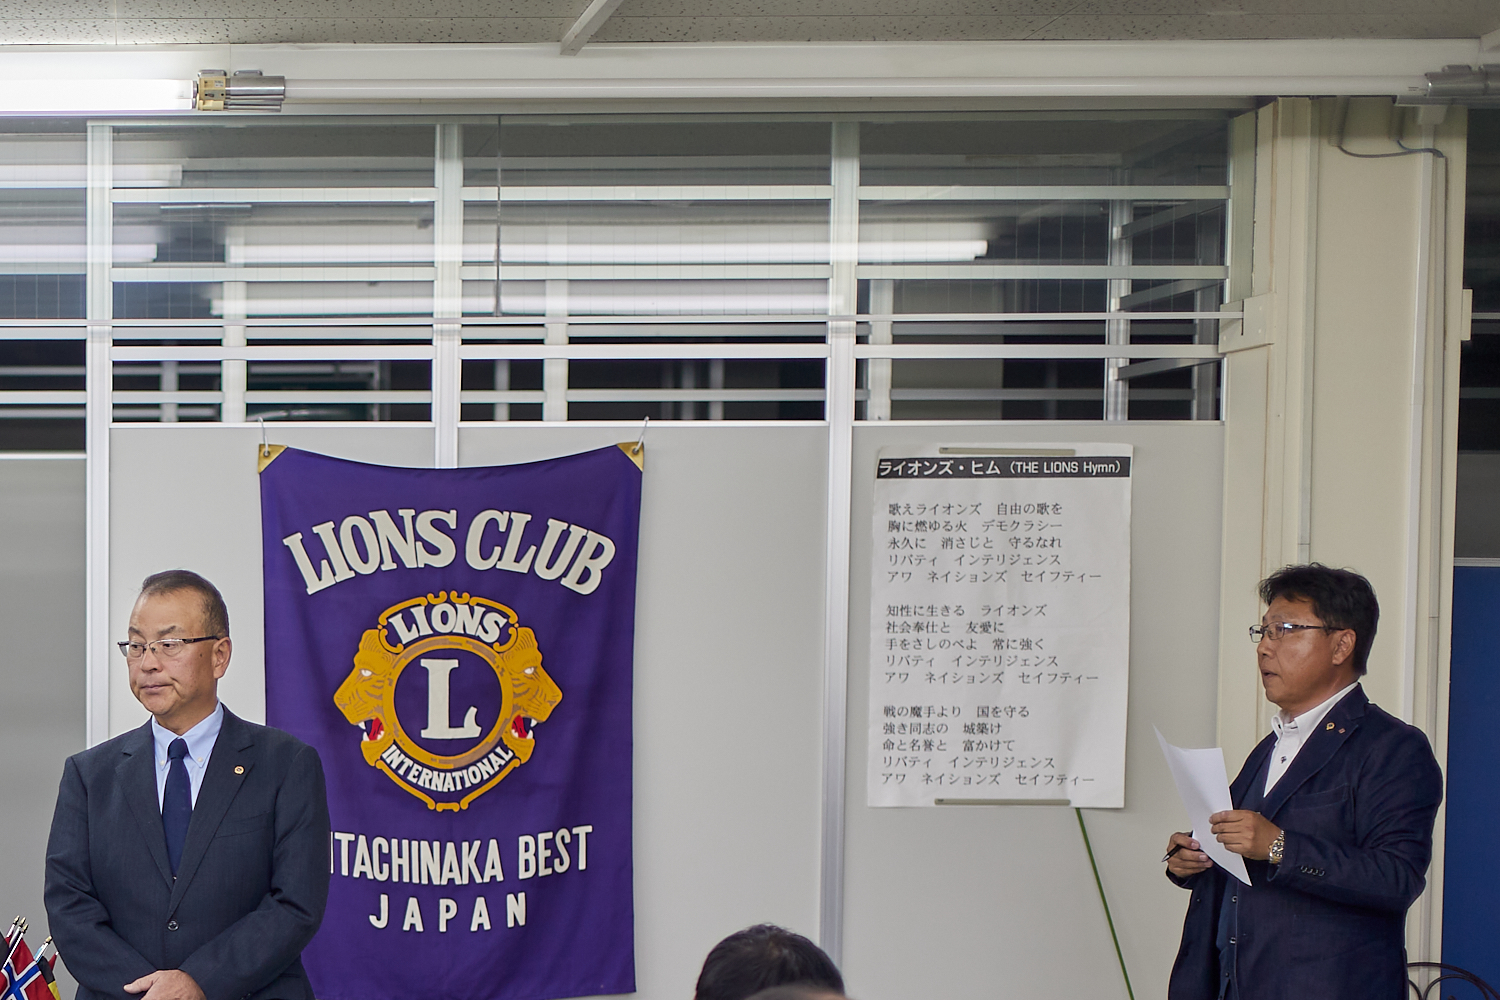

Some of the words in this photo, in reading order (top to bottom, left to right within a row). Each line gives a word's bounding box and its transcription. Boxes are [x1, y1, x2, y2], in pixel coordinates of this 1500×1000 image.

[878, 459, 1001, 476] ライオンズ・ヒム
[1043, 461, 1079, 474] LIONS
[282, 509, 457, 596] LIONS
[464, 509, 616, 596] CLUB
[387, 603, 508, 645] LIONS
[420, 658, 484, 741] L
[381, 743, 515, 793] INTERNATIONAL
[330, 829, 504, 886] TACHINAKA
[517, 824, 593, 881] BEST
[368, 890, 526, 933] JAPAN
